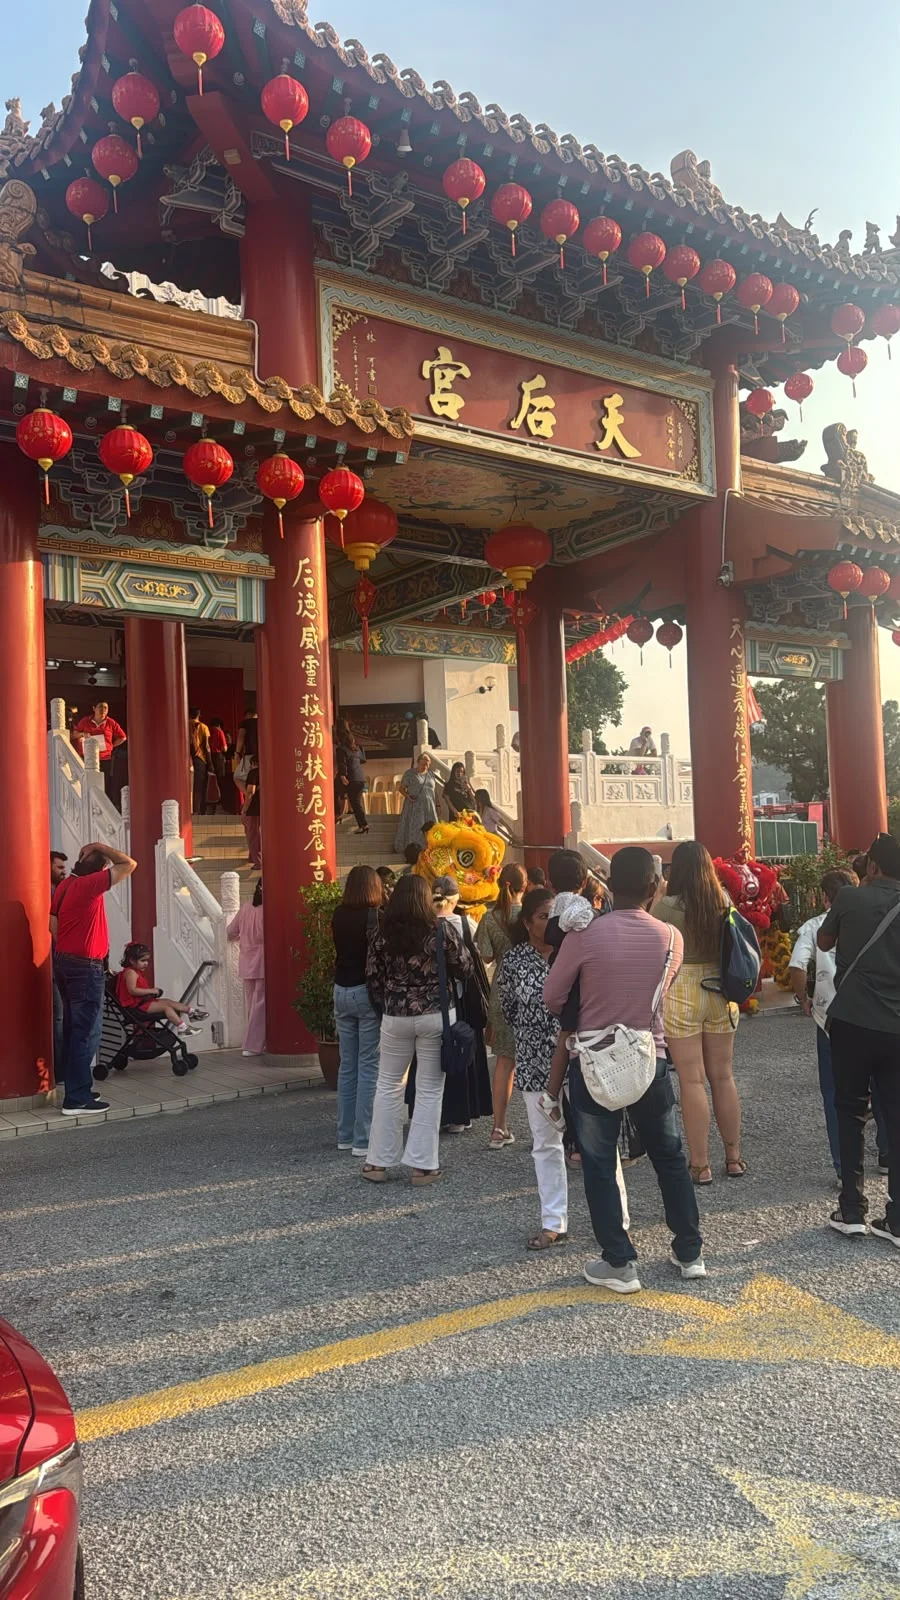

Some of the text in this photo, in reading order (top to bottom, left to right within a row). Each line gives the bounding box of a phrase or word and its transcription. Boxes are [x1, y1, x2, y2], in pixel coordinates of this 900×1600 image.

[292, 557, 328, 882] 后德威靈救溺扶危震古
